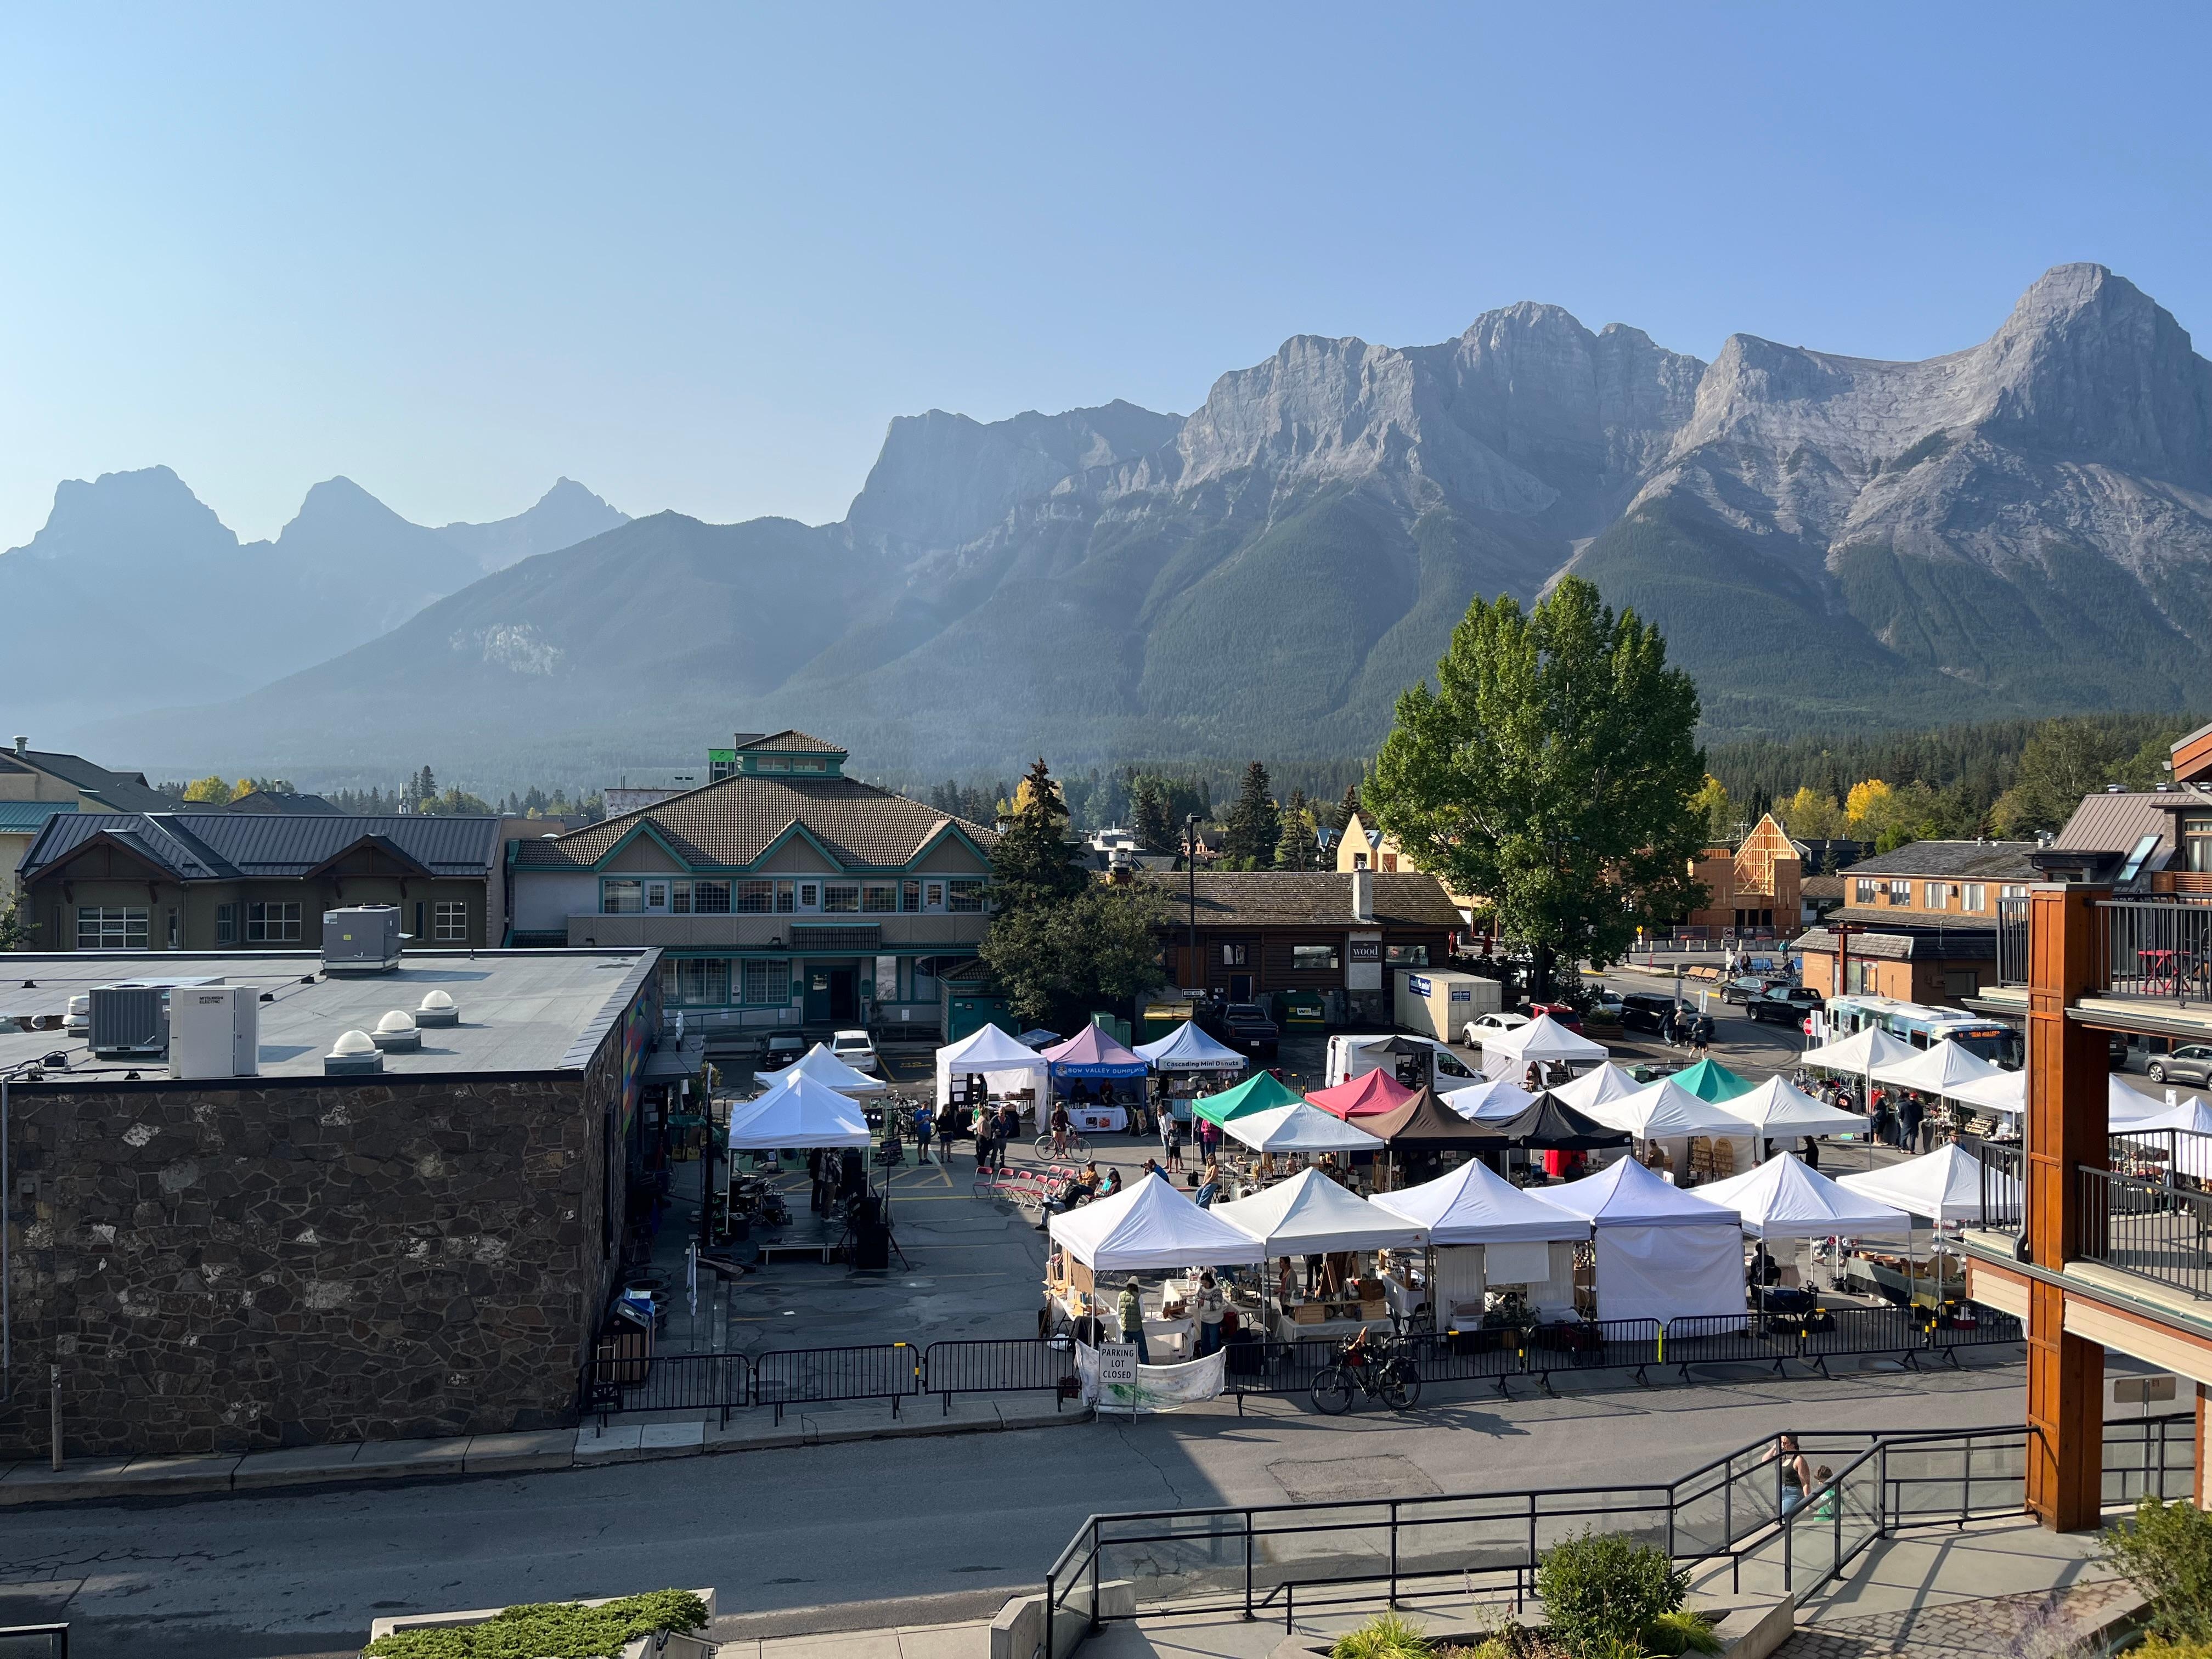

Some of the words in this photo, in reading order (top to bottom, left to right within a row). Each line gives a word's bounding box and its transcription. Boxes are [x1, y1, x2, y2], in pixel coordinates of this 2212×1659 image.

[1353, 945, 1378, 955] wood
[1102, 1348, 1134, 1357] PARKING
[1103, 1370, 1131, 1379] CLOSED
